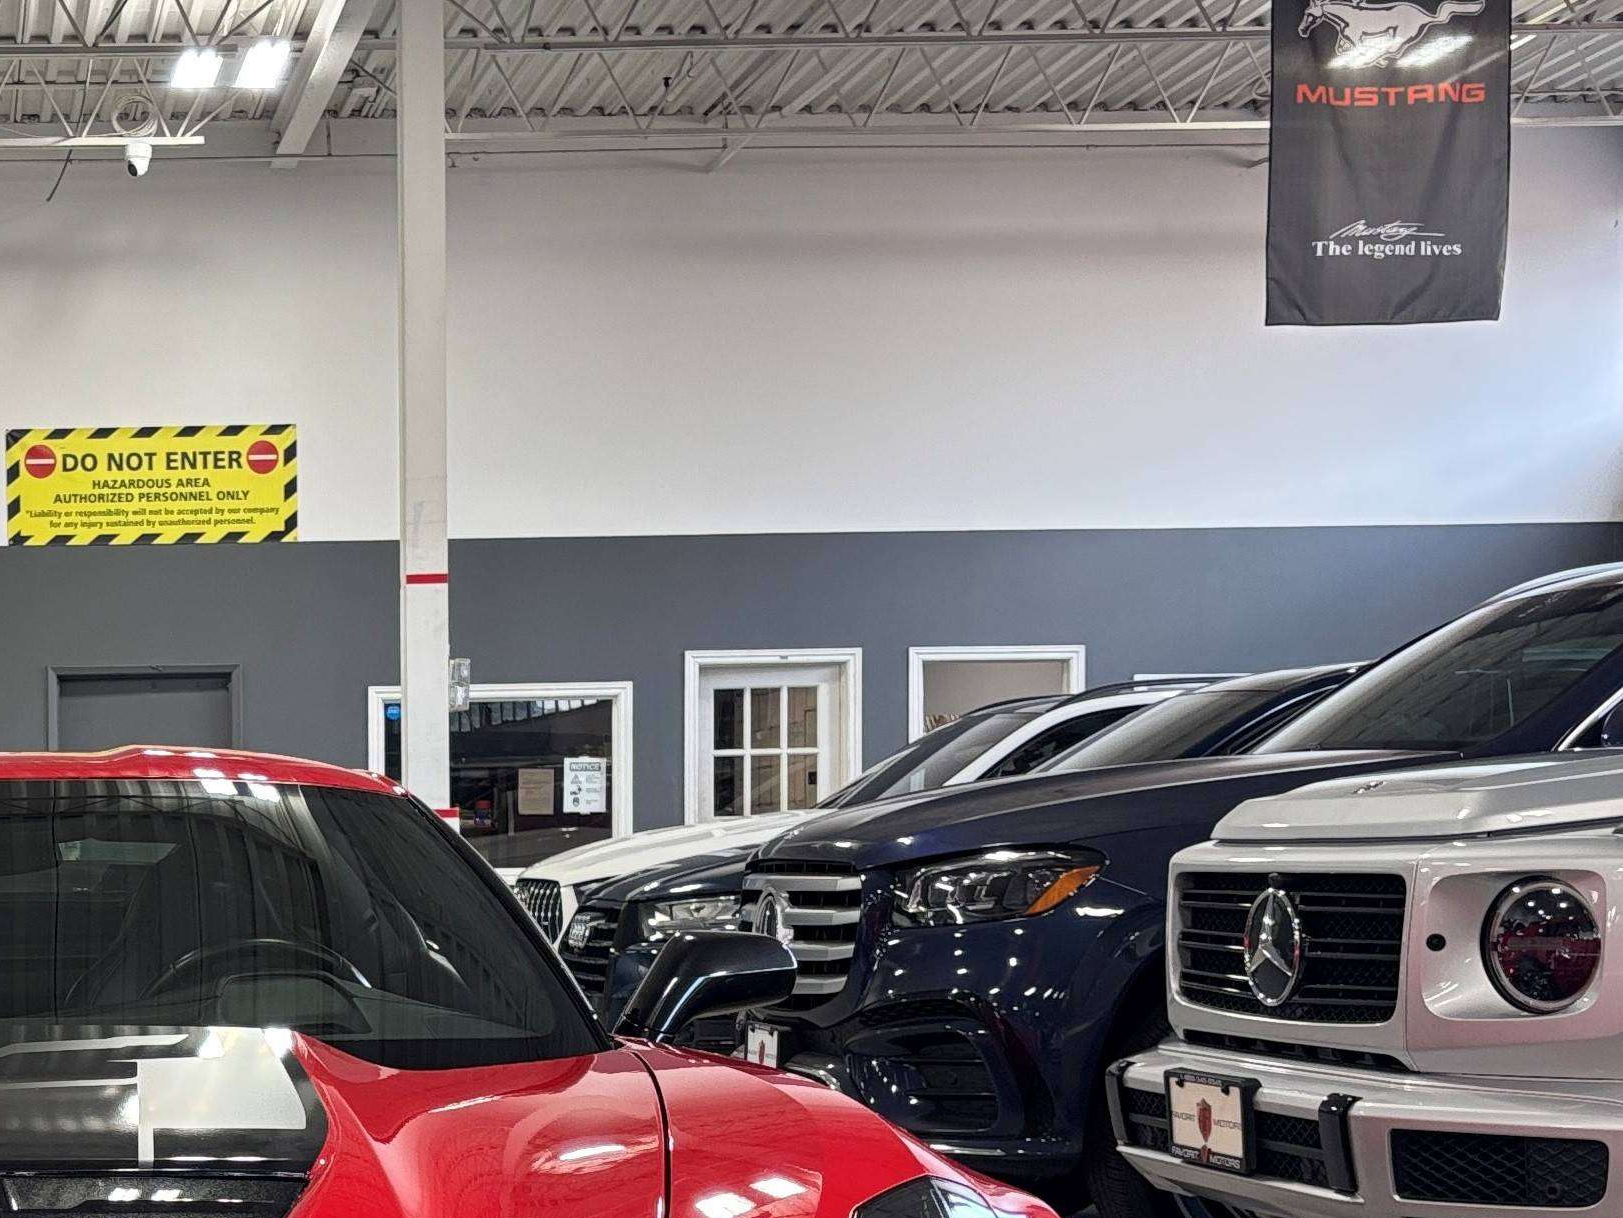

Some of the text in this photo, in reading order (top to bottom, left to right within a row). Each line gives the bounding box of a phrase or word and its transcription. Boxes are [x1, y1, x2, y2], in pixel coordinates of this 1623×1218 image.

[1296, 83, 1486, 107] MUSTANG
[1312, 240, 1462, 260] The legend lives
[62, 450, 243, 473] DO NOT ENTER
[92, 477, 210, 490] HAZARDOUS AREA
[53, 490, 250, 505] AUTHORIZED PERSONNEL ONLY
[75, 509, 129, 519] responsibility
[132, 508, 147, 516] will
[148, 508, 163, 516] not
[165, 507, 175, 516] be
[177, 507, 213, 517] accepted
[215, 507, 225, 516] by
[227, 507, 241, 515] our
[243, 506, 280, 515] company
[50, 516, 256, 530] for any injury sustained by unauthorized personnel.
